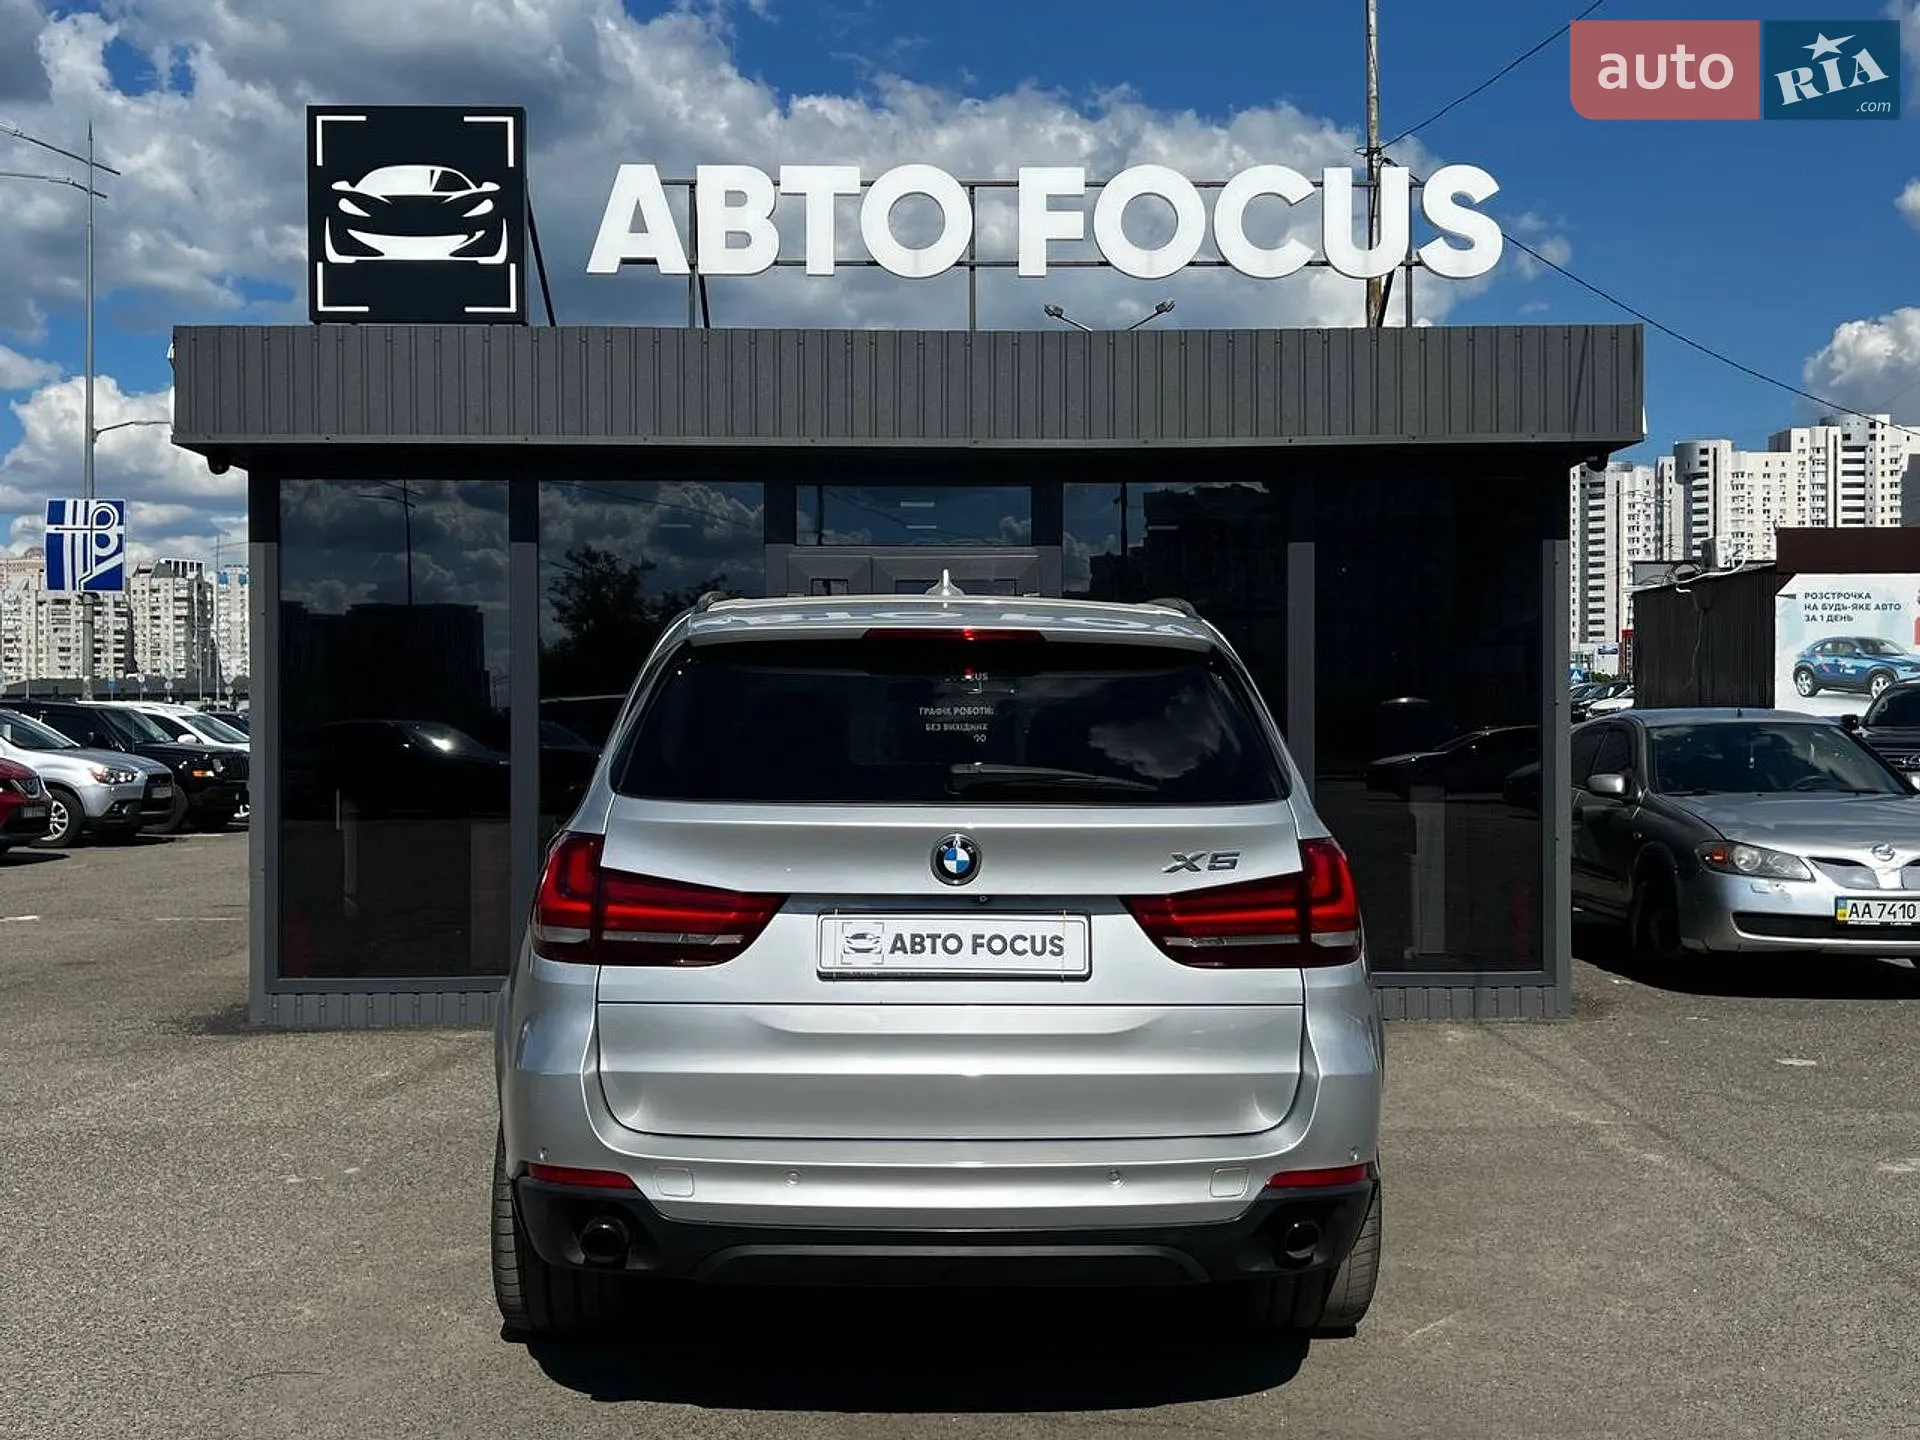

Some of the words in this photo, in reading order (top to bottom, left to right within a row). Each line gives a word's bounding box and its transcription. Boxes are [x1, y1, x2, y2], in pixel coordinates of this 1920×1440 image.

[586, 164, 974, 279] АВТО
[1017, 164, 1504, 279] FOCUS
[1804, 592, 1872, 600] РОЗСТРОЧКА
[1804, 603, 1819, 611] НА
[1821, 603, 1871, 612] БУДЬ-ЯКЕ
[1874, 603, 1901, 611] АВТО
[1804, 614, 1818, 622] ЗА
[1826, 614, 1854, 623] ДЕНЬ
[1161, 850, 1240, 873] X5
[1848, 902, 1873, 919] AA
[1876, 902, 1917, 920] 7410
[889, 933, 963, 956] АВТО
[971, 934, 1065, 957] FOCUS
